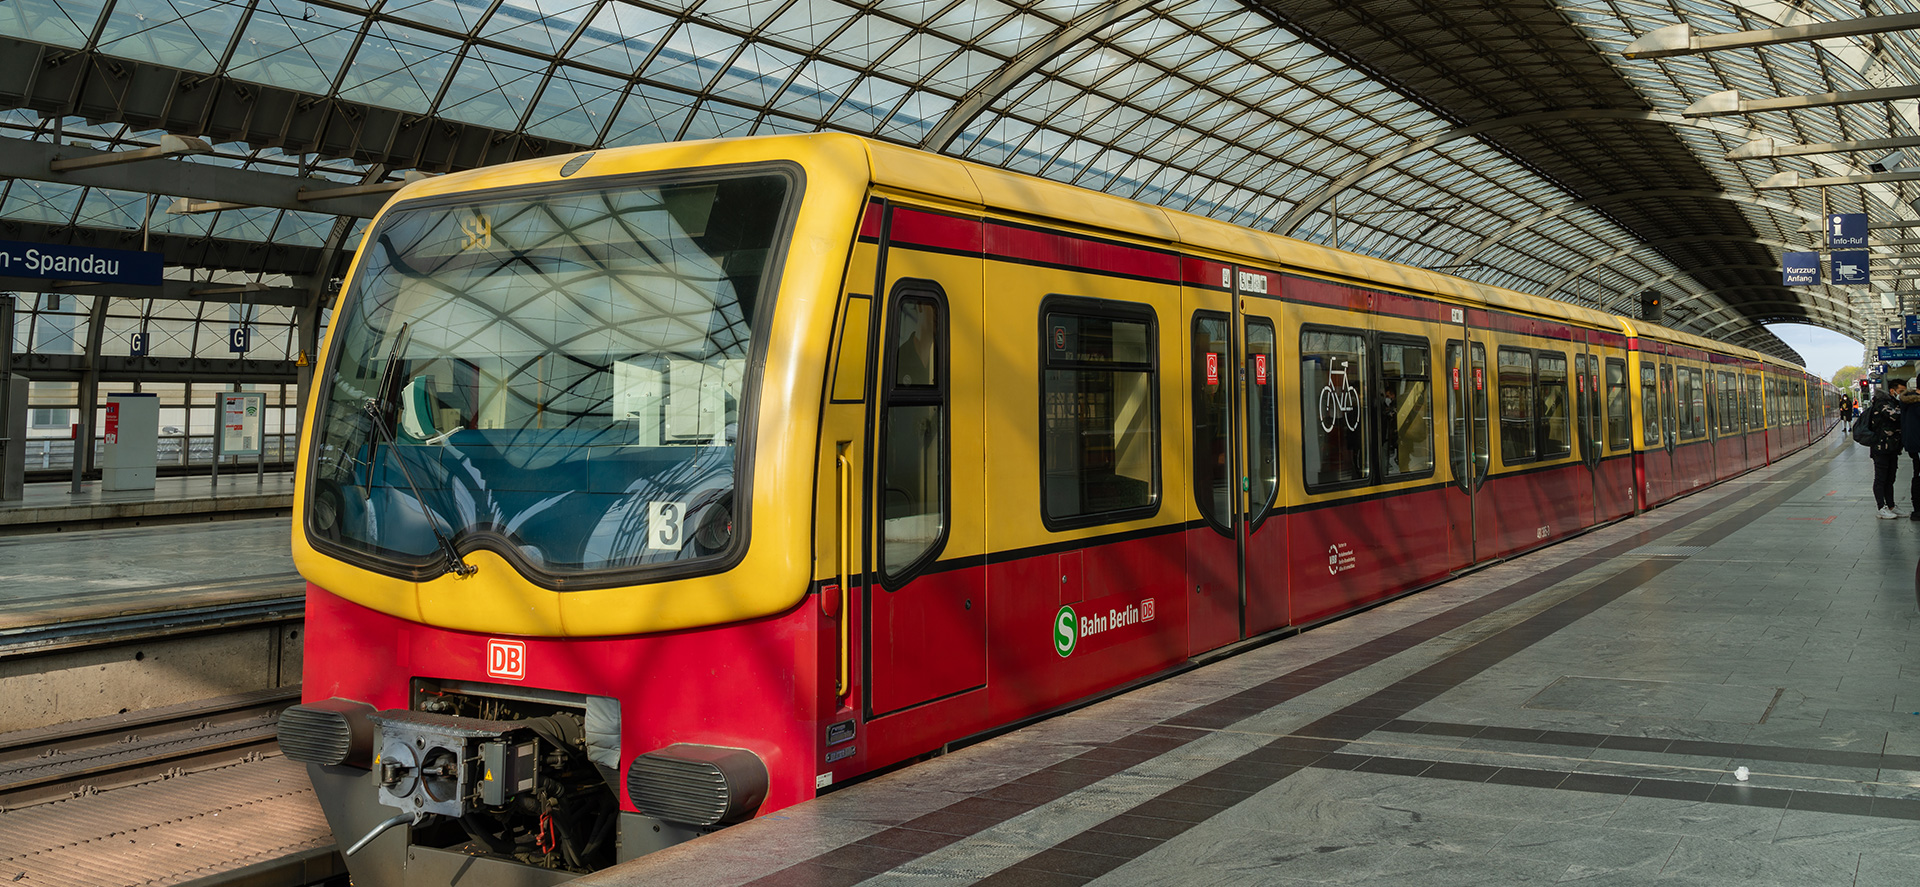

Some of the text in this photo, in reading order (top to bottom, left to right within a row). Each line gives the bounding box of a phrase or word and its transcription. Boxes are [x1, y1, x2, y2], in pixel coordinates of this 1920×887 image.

[461, 213, 492, 251] S9
[1833, 237, 1863, 245] Info-Ruf
[0, 248, 120, 276] n-Spandau
[1786, 266, 1816, 275] Kurzzug
[1787, 275, 1813, 283] Anfang
[131, 333, 141, 352] G
[234, 328, 244, 348] G
[659, 503, 679, 546] 3
[1058, 601, 1153, 652] S Bahn Berlin DB
[491, 644, 522, 674] DB
